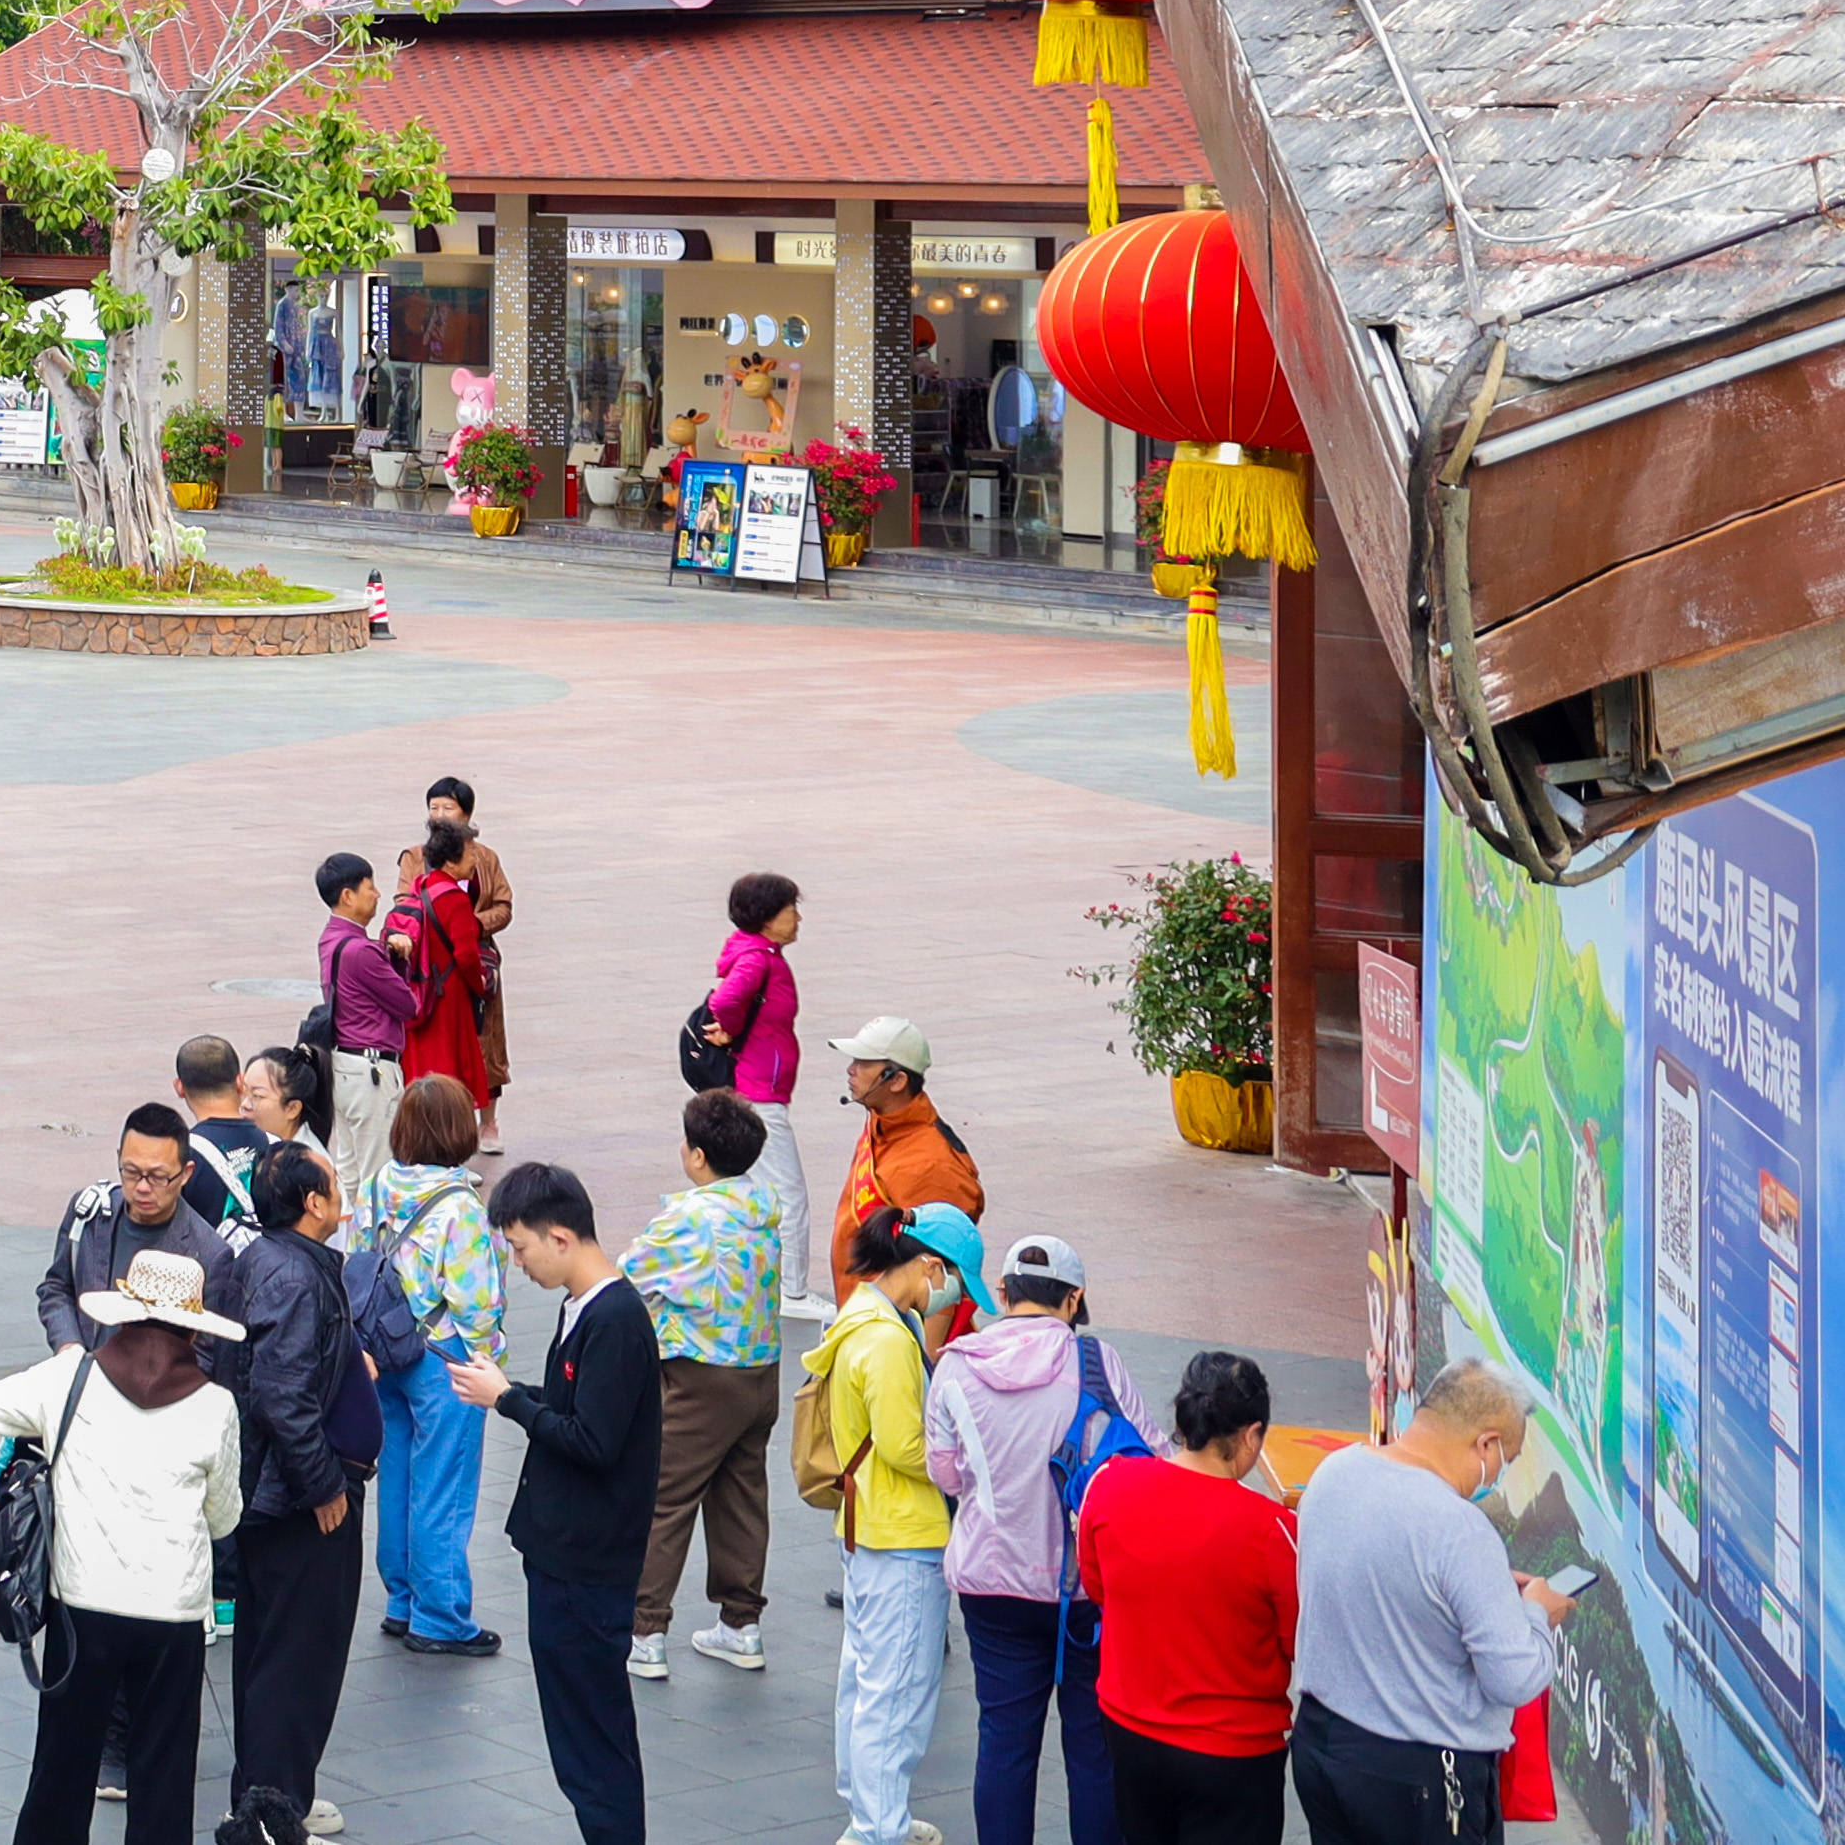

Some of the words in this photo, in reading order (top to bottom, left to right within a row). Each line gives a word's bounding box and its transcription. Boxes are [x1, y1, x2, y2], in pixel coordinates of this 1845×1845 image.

[1654, 819, 1801, 1022] 鹿回头风景区
[1653, 941, 1802, 1126] 实名制预约入园流程
